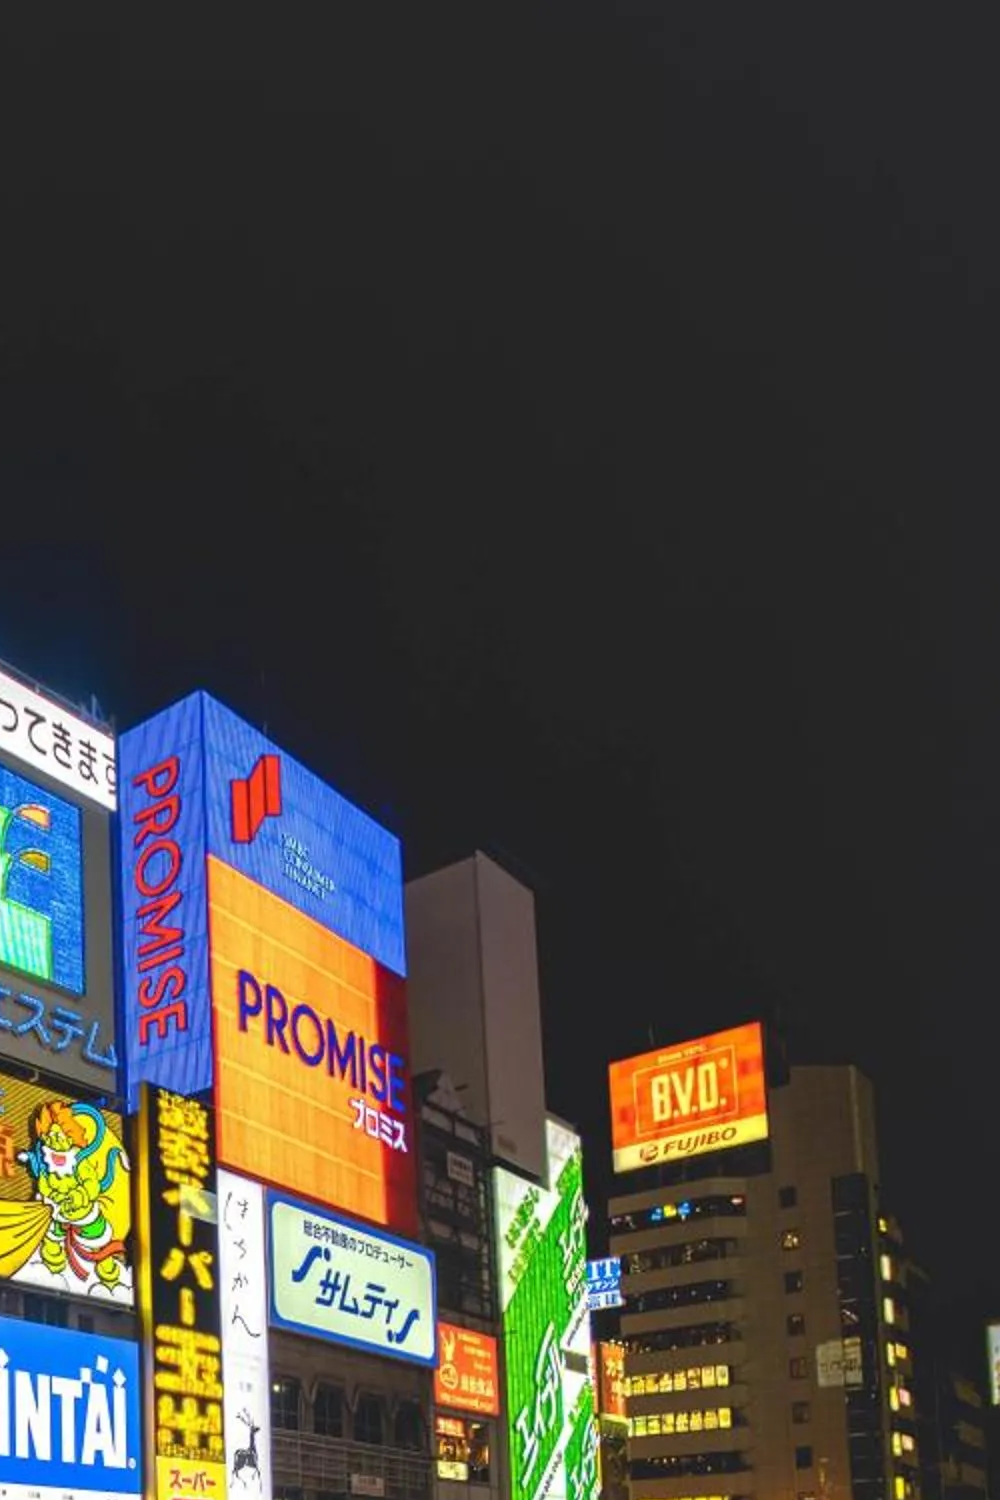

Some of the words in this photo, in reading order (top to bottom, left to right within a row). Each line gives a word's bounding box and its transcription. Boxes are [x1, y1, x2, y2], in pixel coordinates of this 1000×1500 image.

[132, 754, 188, 1046] PROMISE
[237, 968, 407, 1114] PROMISE
[349, 1098, 409, 1153] プロミス
[663, 1126, 738, 1154] FUJIBO
[169, 1468, 217, 1493] スーパー
